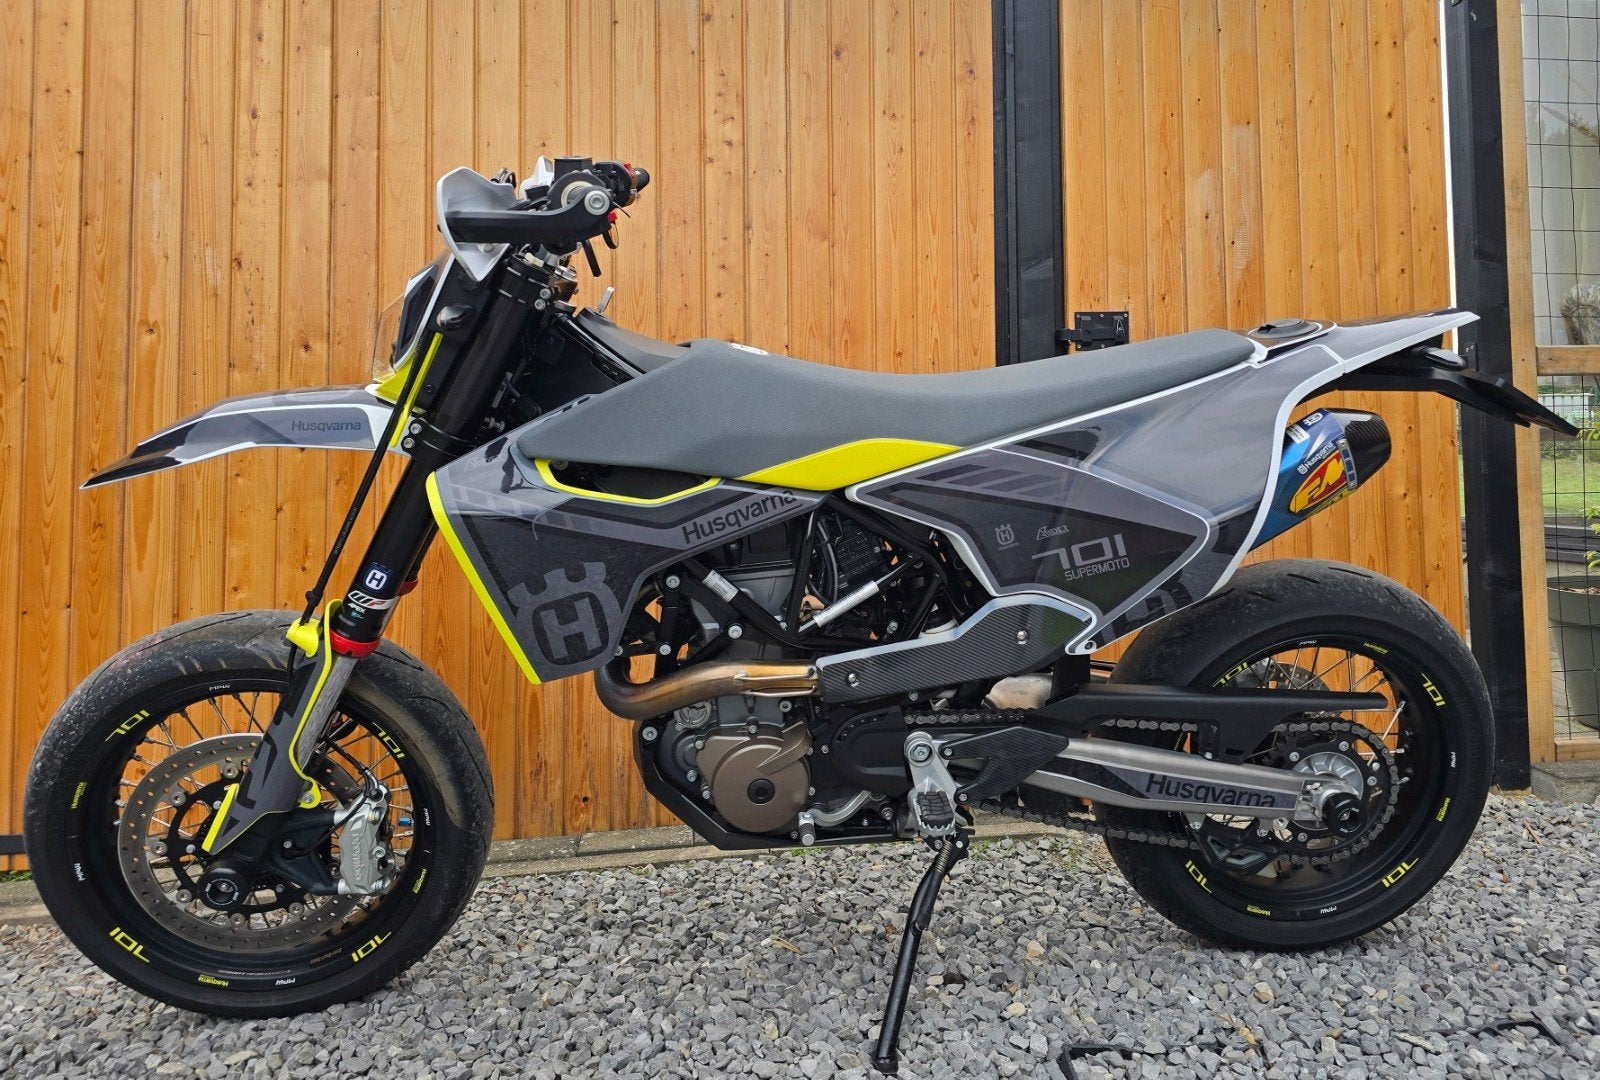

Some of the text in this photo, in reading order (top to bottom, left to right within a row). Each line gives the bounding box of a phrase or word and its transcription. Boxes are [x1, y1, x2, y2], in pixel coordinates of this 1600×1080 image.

[291, 420, 362, 433] Husqvarna
[1304, 441, 1336, 469] Husqvarna
[682, 490, 798, 544] Husqvarna
[1031, 533, 1127, 570] 701
[1064, 557, 1130, 581] SUPERMOTO
[1212, 661, 1248, 686] 701
[1420, 672, 1446, 708] 701
[105, 709, 151, 743] 701
[372, 721, 406, 760] 701
[1145, 773, 1275, 808] Husqvarna
[1185, 859, 1213, 895] 701
[1381, 857, 1420, 888] 701
[109, 926, 150, 964] 701
[351, 930, 392, 962] 701
